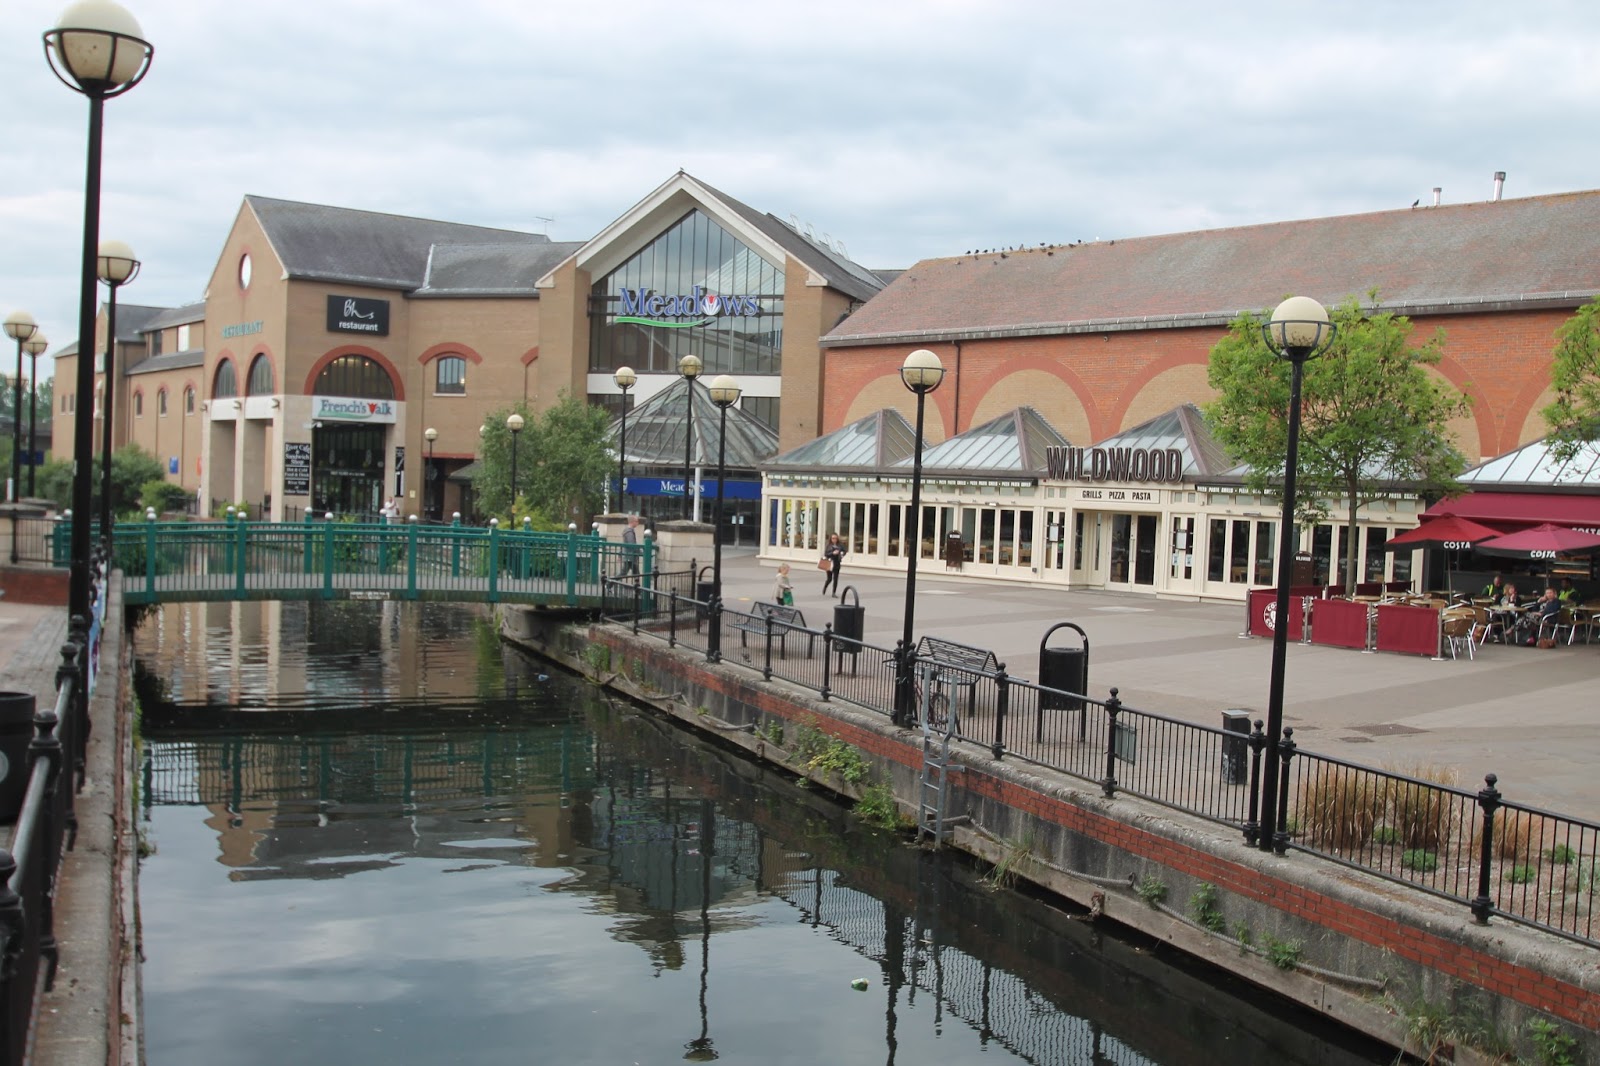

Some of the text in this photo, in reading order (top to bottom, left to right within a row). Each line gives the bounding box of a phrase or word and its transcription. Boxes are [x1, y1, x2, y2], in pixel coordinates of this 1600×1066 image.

[618, 285, 759, 316] Meadows
[339, 321, 378, 332] restaurant
[321, 400, 366, 413] French's
[1046, 446, 1183, 484] WILDWOOD
[1082, 490, 1151, 501] GRILLS PIZZA PASTA
[1443, 541, 1471, 550] COSTA
[1530, 550, 1556, 559] COSTA
